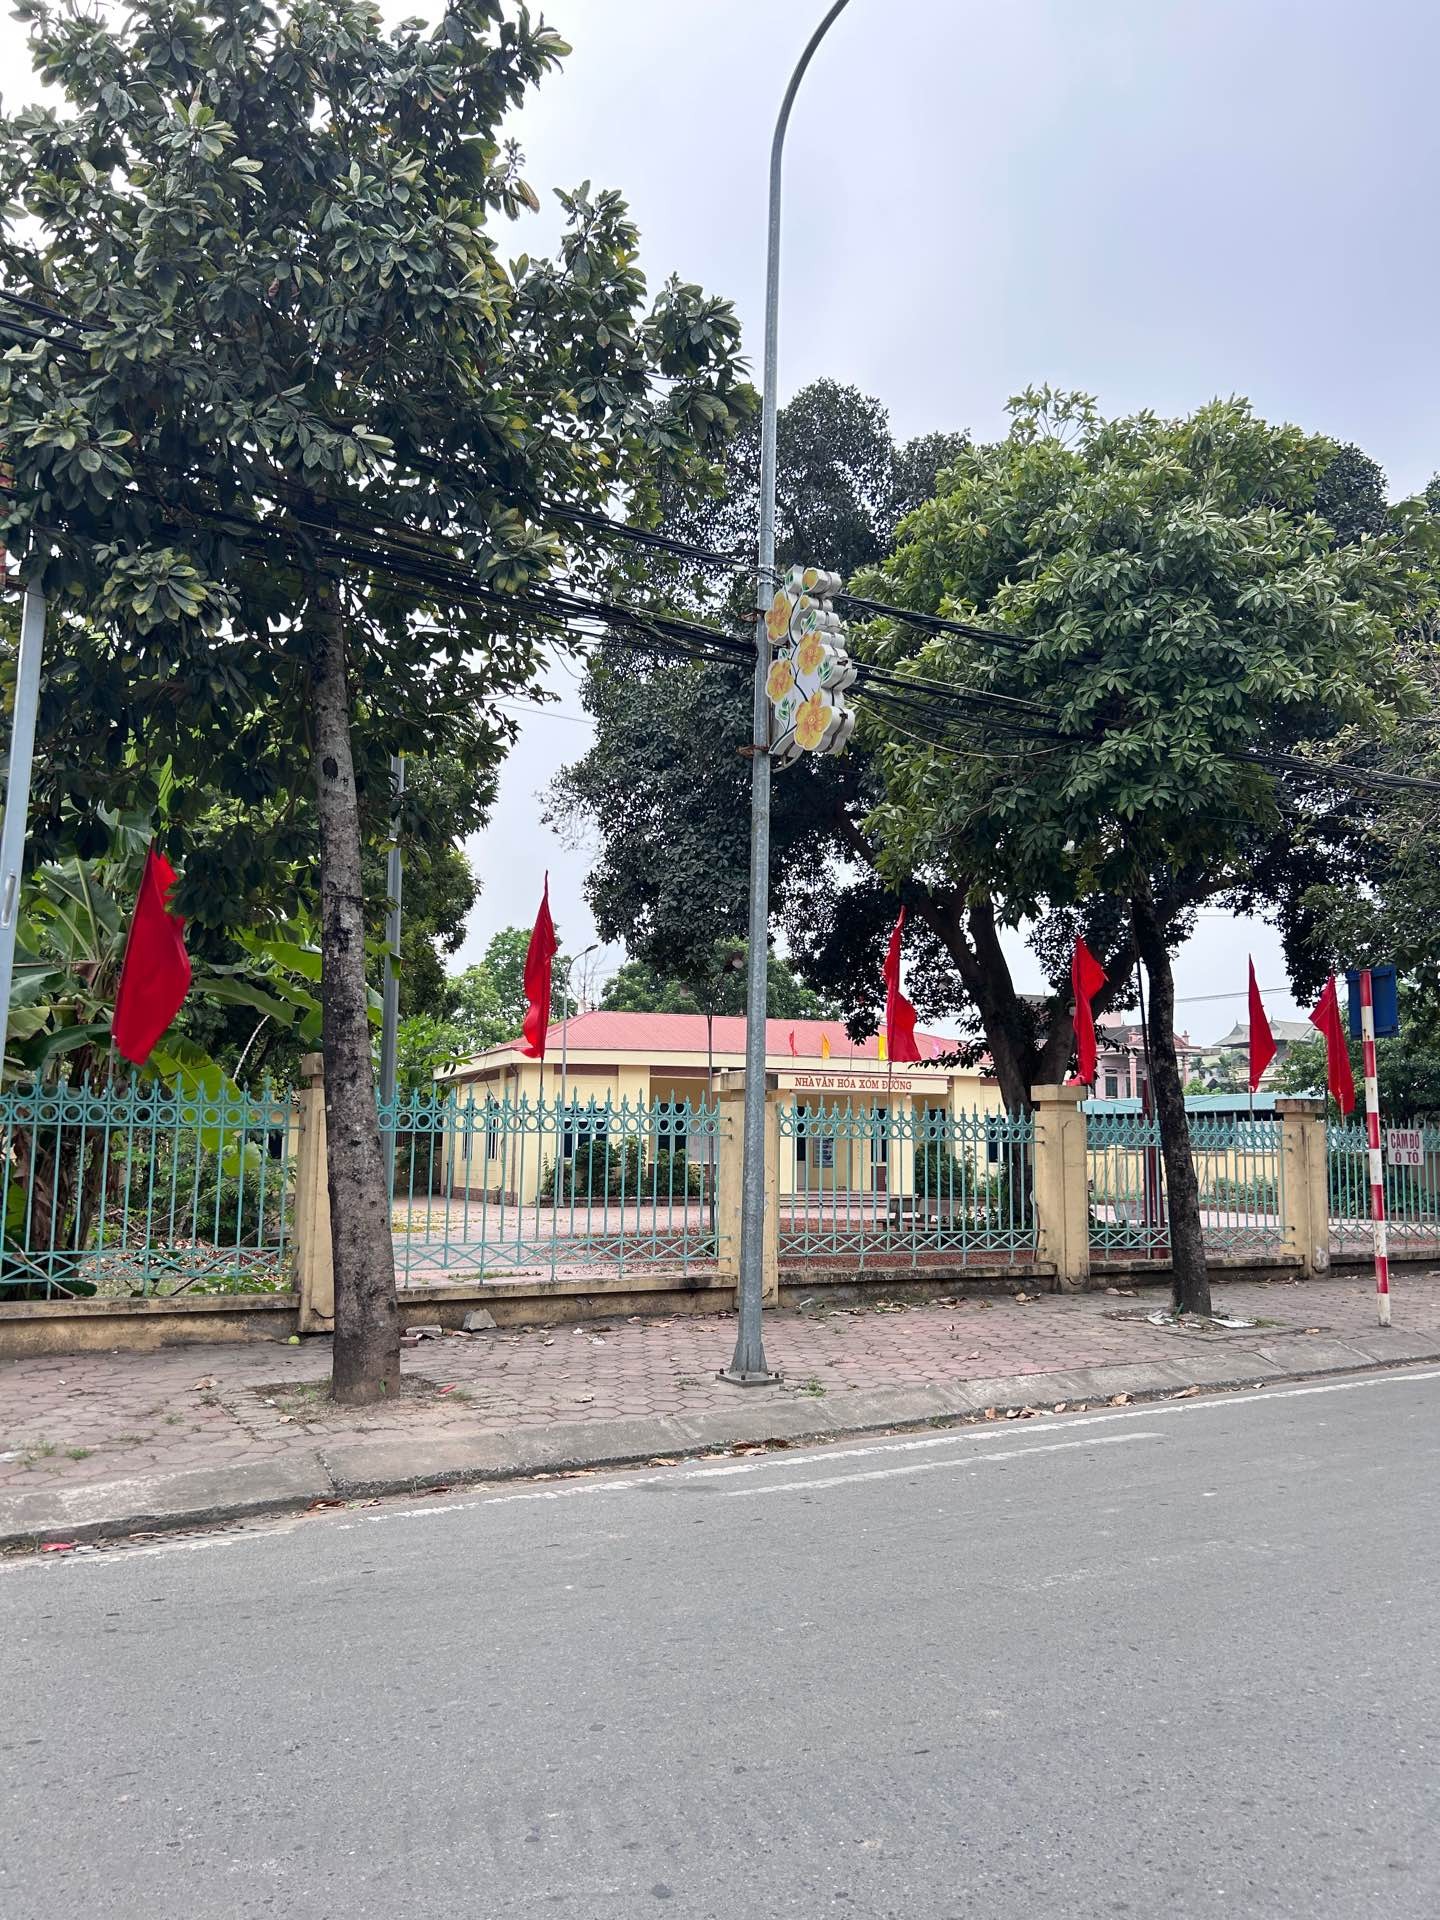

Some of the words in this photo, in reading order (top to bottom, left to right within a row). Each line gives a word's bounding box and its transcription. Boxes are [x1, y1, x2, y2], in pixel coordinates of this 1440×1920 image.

[794, 1075, 814, 1087] NHÀ
[815, 1076, 834, 1088] VĂN
[837, 1076, 856, 1089] HÓA
[859, 1076, 879, 1089] XÓM
[1395, 1149, 1402, 1163] Ô
[1406, 1149, 1419, 1163] TÔ
